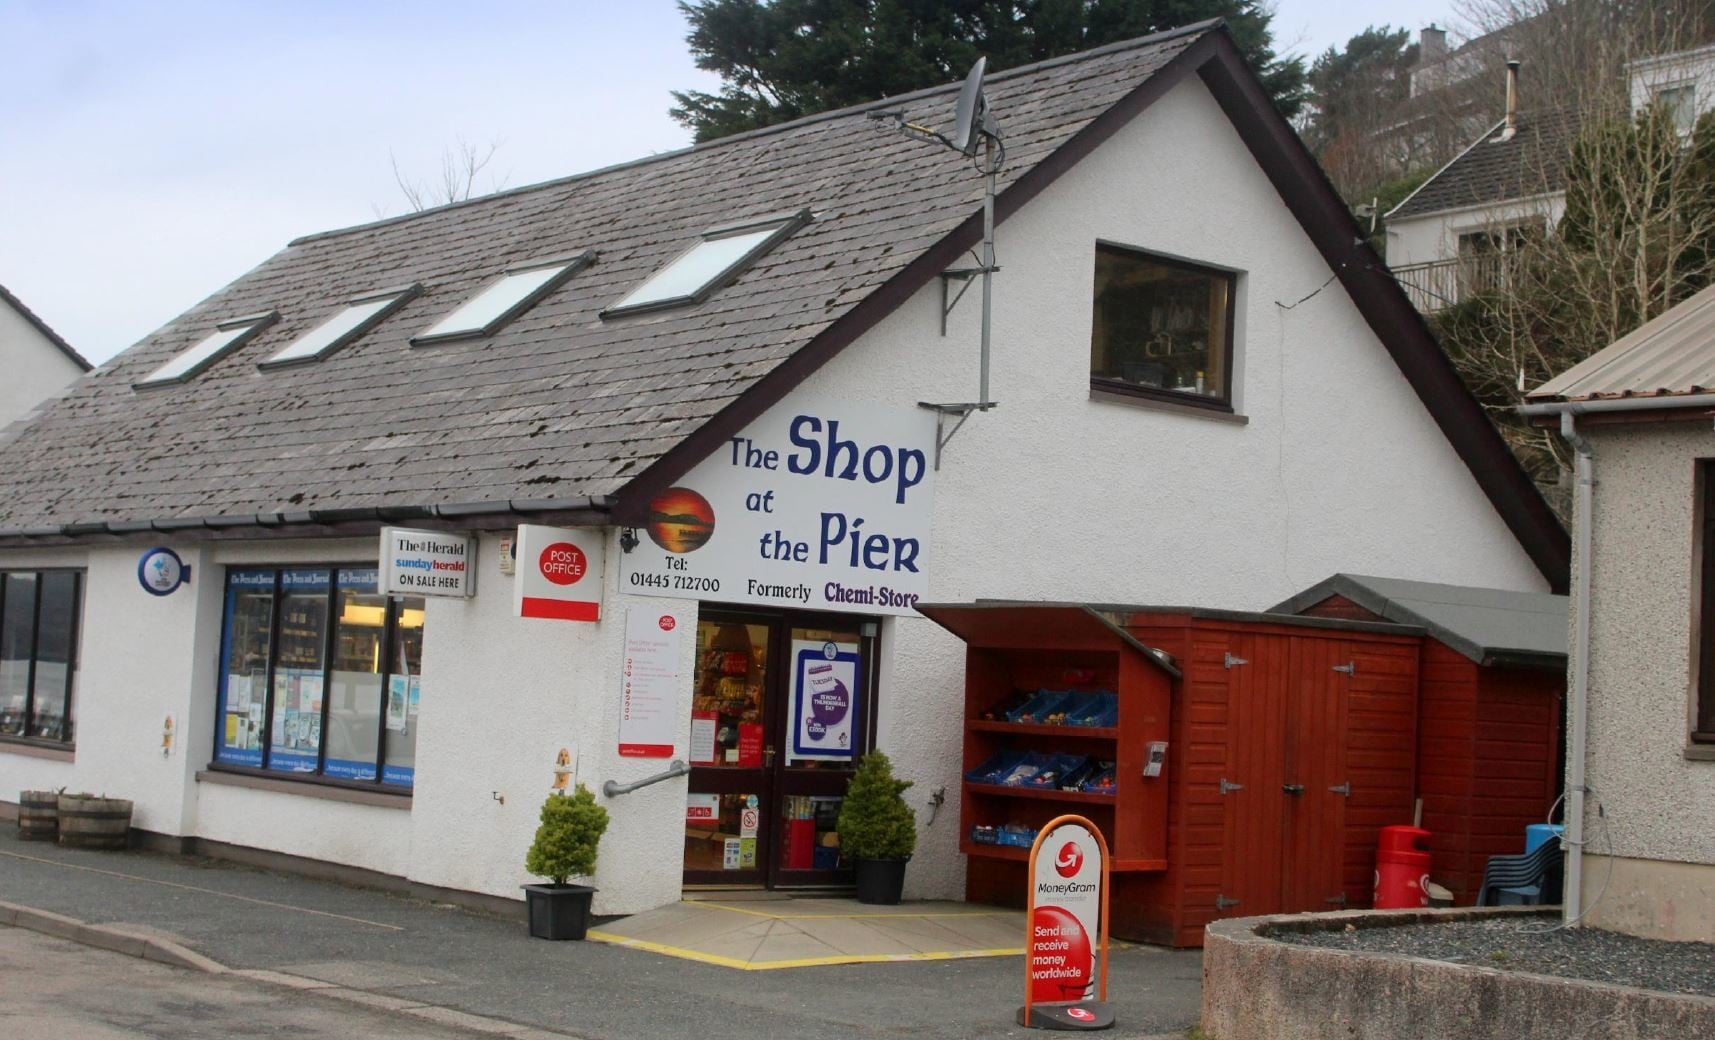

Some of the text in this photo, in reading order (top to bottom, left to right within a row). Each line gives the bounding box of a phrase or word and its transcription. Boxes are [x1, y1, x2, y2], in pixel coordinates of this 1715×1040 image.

[730, 415, 926, 504] The Shop
[746, 490, 775, 513] at
[397, 539, 464, 555] The Herald
[760, 530, 809, 562] the
[550, 551, 578, 563] POST
[665, 556, 688, 571] Tel:
[543, 562, 581, 576] OFFICE
[400, 574, 459, 588] ON SALE HERE
[630, 572, 720, 592] 01445 712700
[747, 579, 919, 608] Formerly Chemi-Store
[1038, 882, 1096, 896] MoneyGram
[1035, 926, 1079, 937] Send and
[1034, 939, 1069, 950] receive
[1033, 955, 1066, 967] money
[1033, 967, 1081, 979] worldwide
